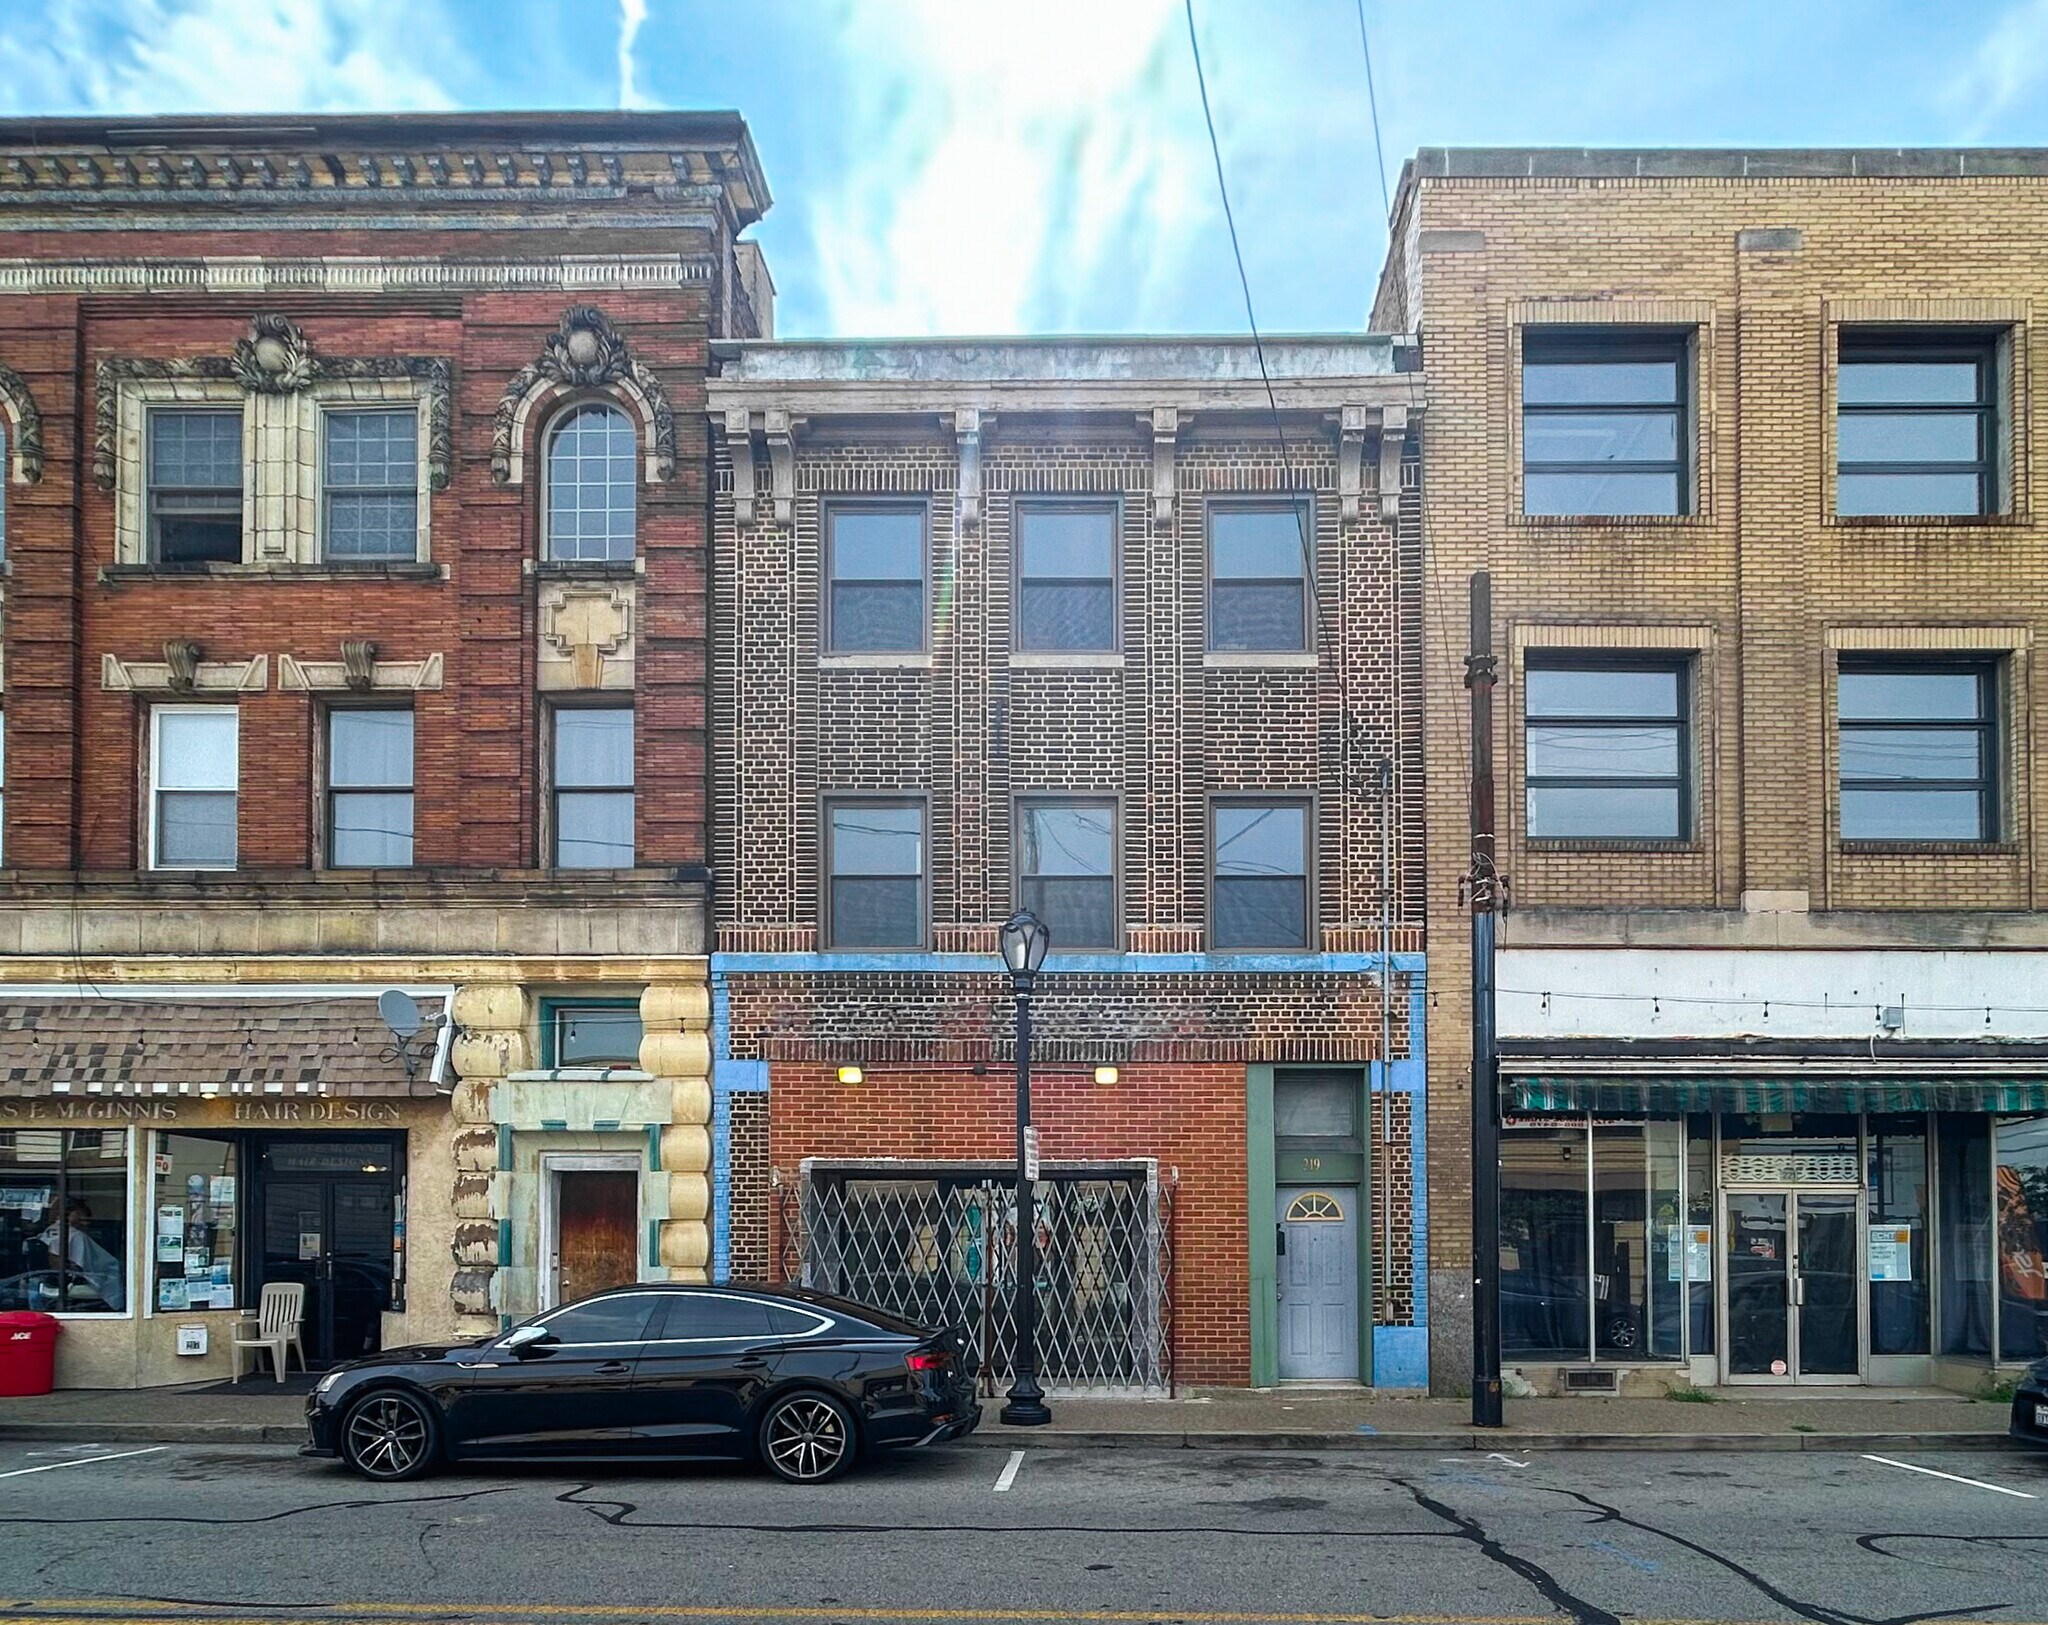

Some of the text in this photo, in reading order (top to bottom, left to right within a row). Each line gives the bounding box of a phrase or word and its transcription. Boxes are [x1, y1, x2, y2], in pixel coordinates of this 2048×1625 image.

[30, 1102, 46, 1119] E
[234, 1102, 401, 1121] HAIR DESIGN
[1303, 1157, 1321, 1171] 219
[10, 1331, 32, 1341] ACE
